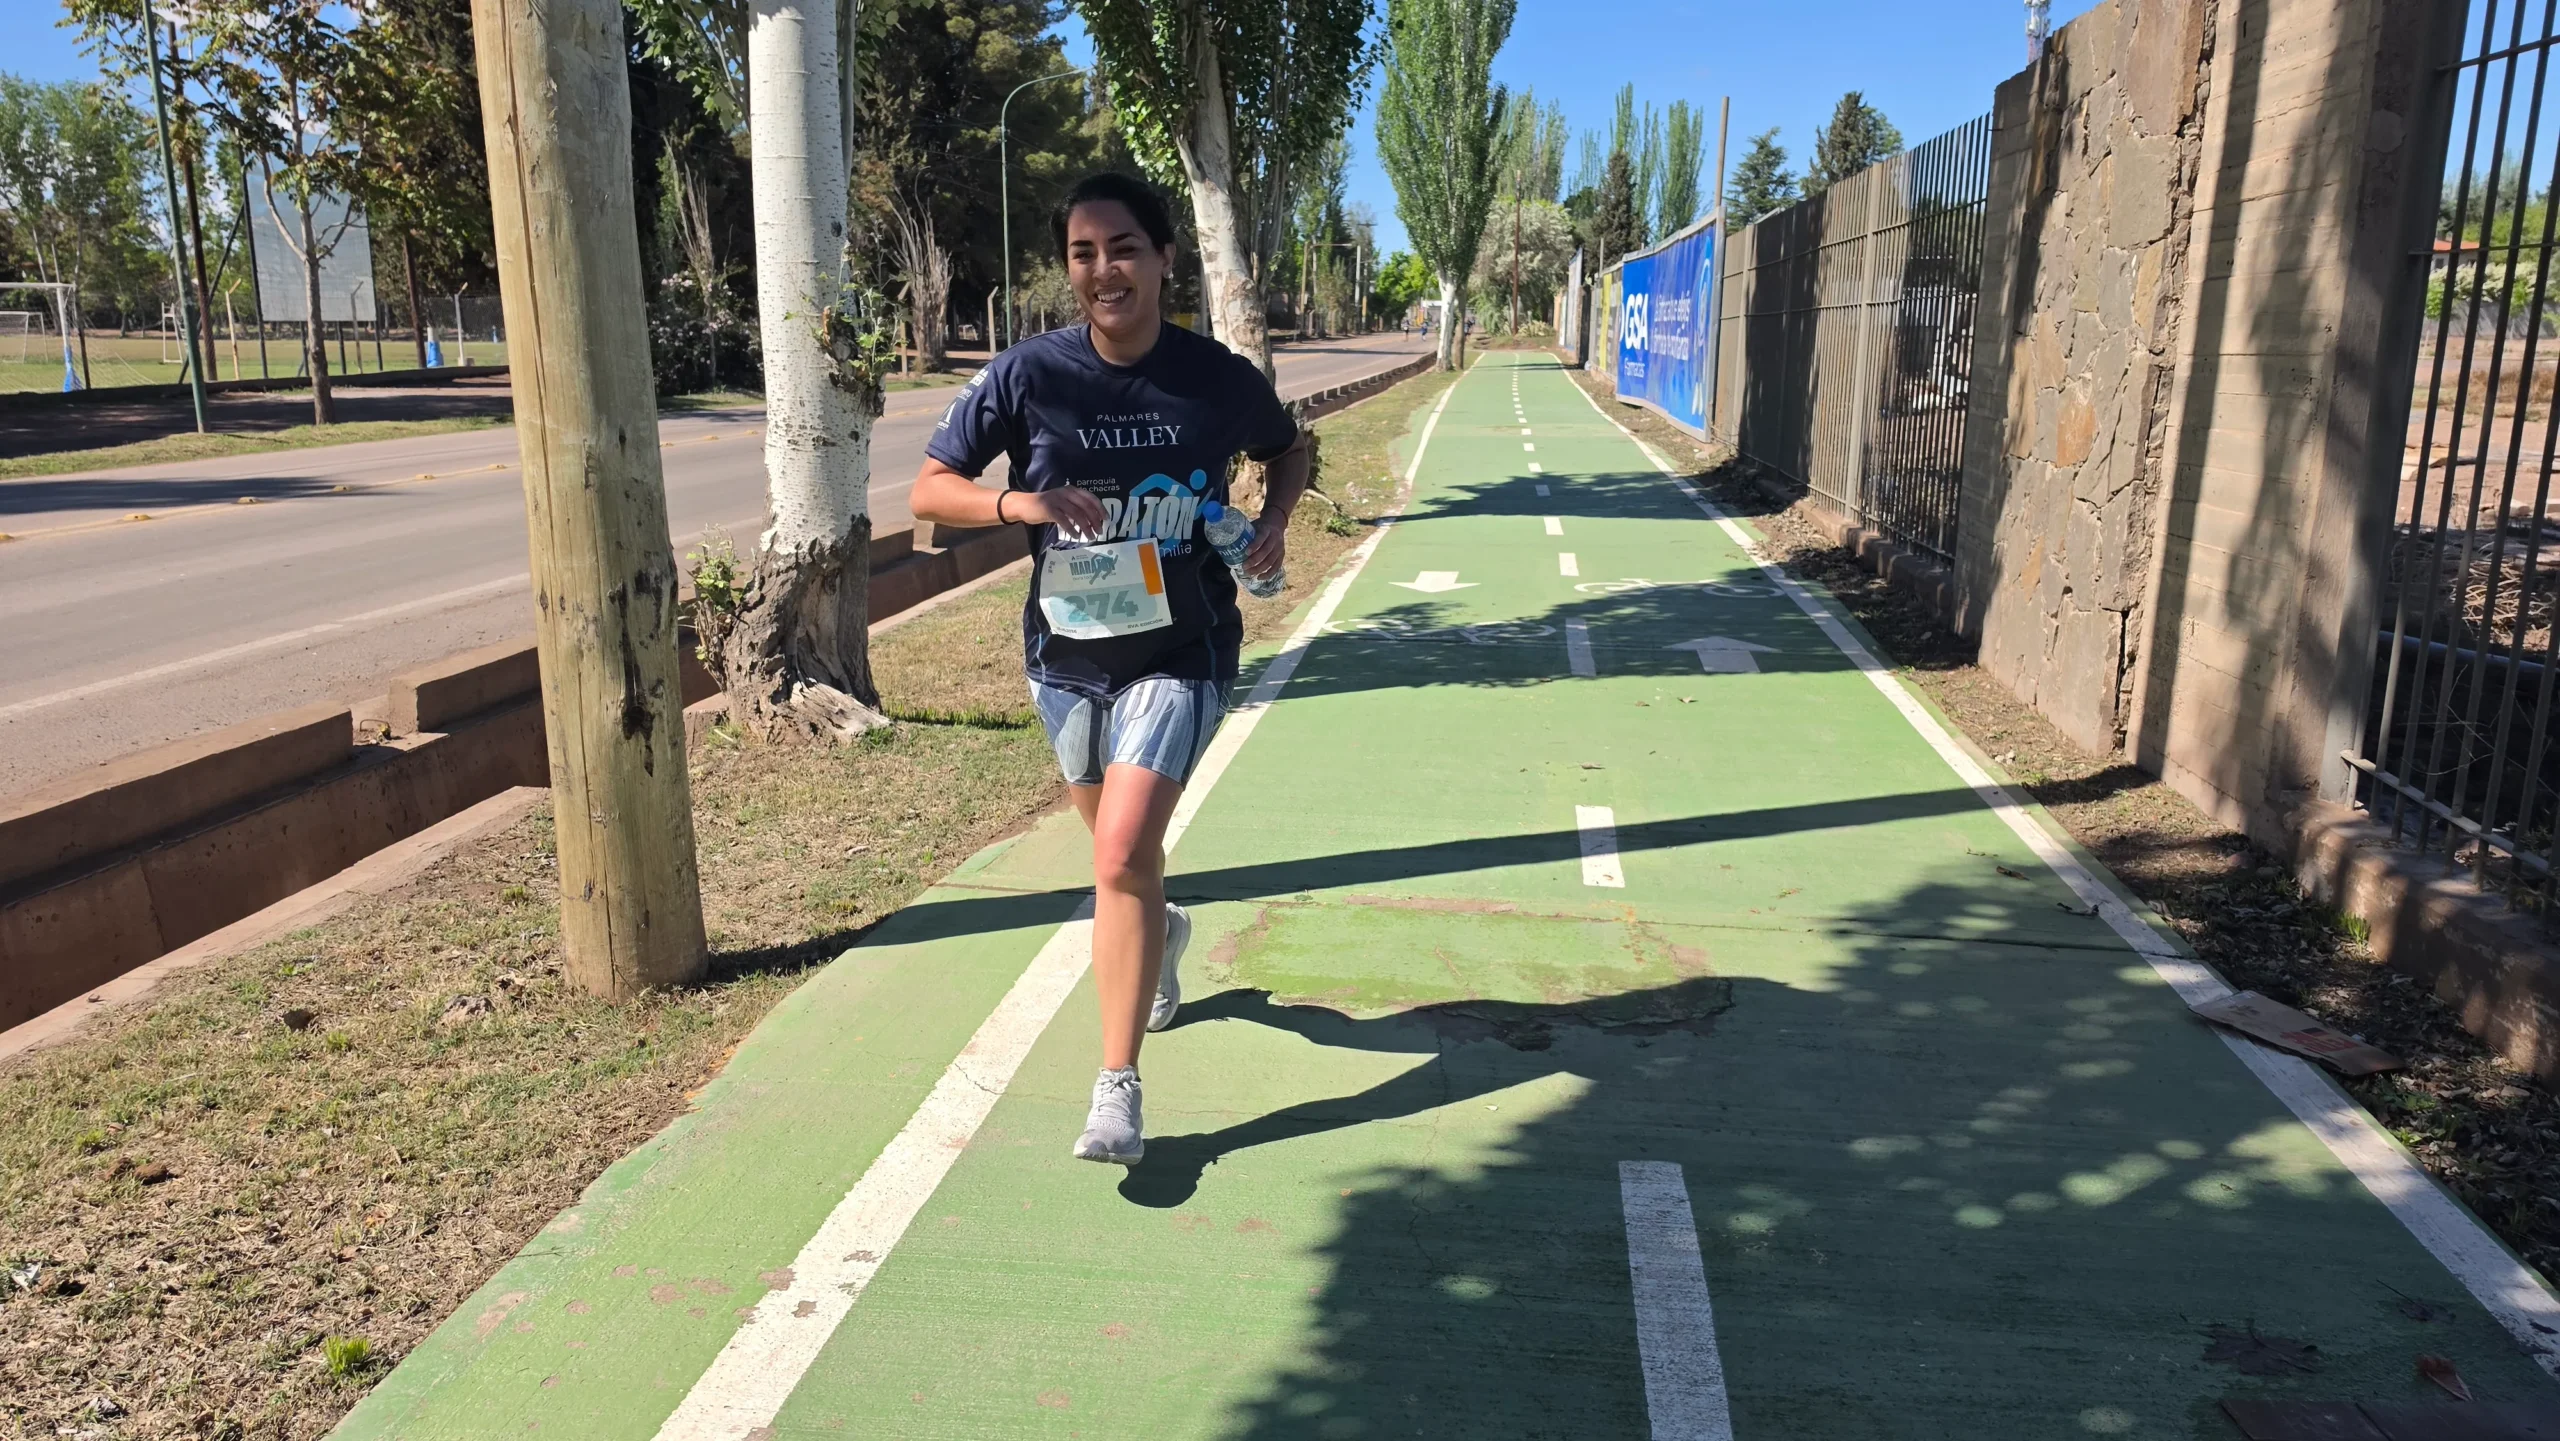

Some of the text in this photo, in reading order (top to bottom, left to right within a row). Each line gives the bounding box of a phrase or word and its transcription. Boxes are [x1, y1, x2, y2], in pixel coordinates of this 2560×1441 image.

[1625, 293, 1649, 351] GSA
[1097, 412, 1160, 423] PALMARES
[1076, 425, 1182, 449] VALLEY
[1076, 477, 1116, 487] parroquia
[1089, 484, 1121, 492] chacras
[1057, 485, 1200, 543] RATÓN
[1158, 543, 1192, 558] milia
[1064, 590, 1139, 623] 274
